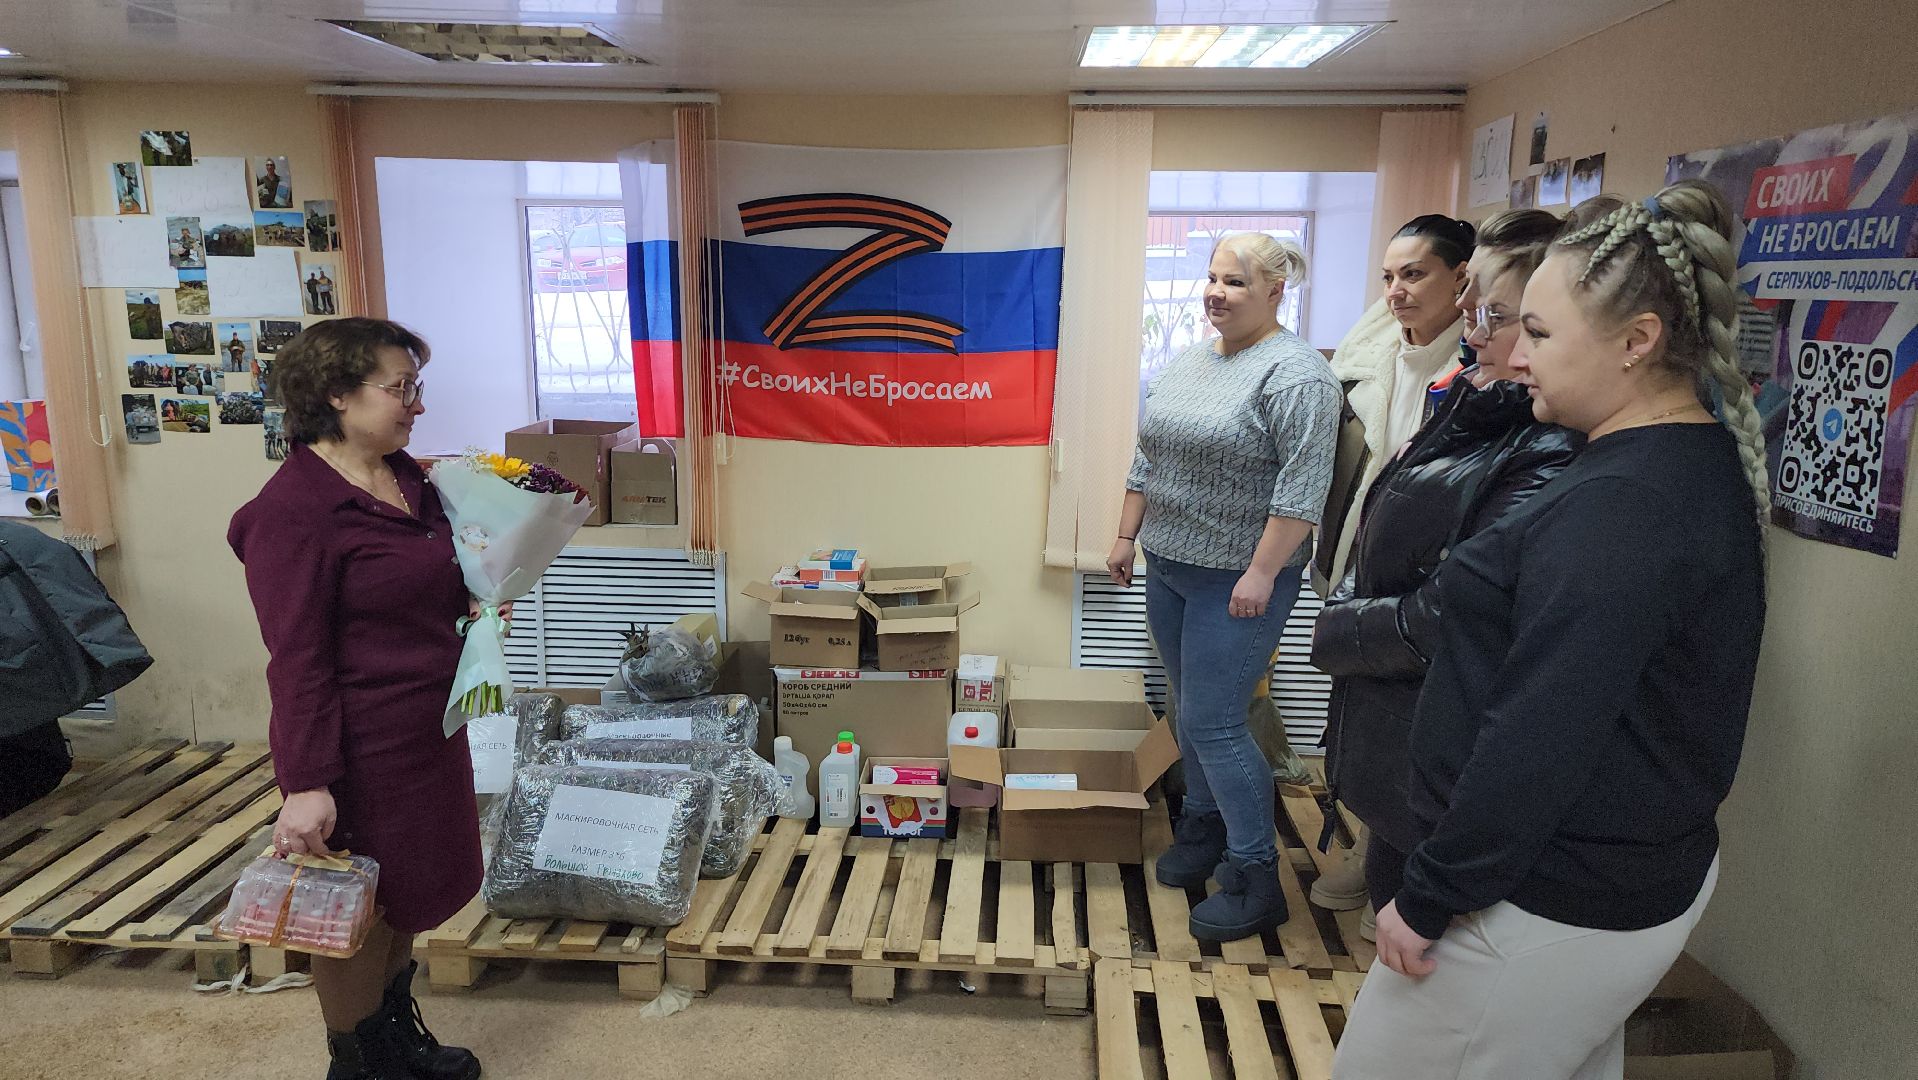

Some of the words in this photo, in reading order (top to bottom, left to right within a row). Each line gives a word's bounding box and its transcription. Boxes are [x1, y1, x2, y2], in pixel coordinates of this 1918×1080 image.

[1756, 167, 1835, 209] СВОИХ
[1758, 223, 1789, 254] НЕ
[1789, 215, 1900, 253] БРОСАЕМ
[715, 361, 993, 407] #СвоихНеБросаем
[782, 683, 810, 691] КОРОБ
[811, 681, 852, 691] СРЕДНИЙ
[554, 812, 637, 832] МАСКИРОВОЧНАЯ
[570, 844, 608, 858] РАЗМЕР
